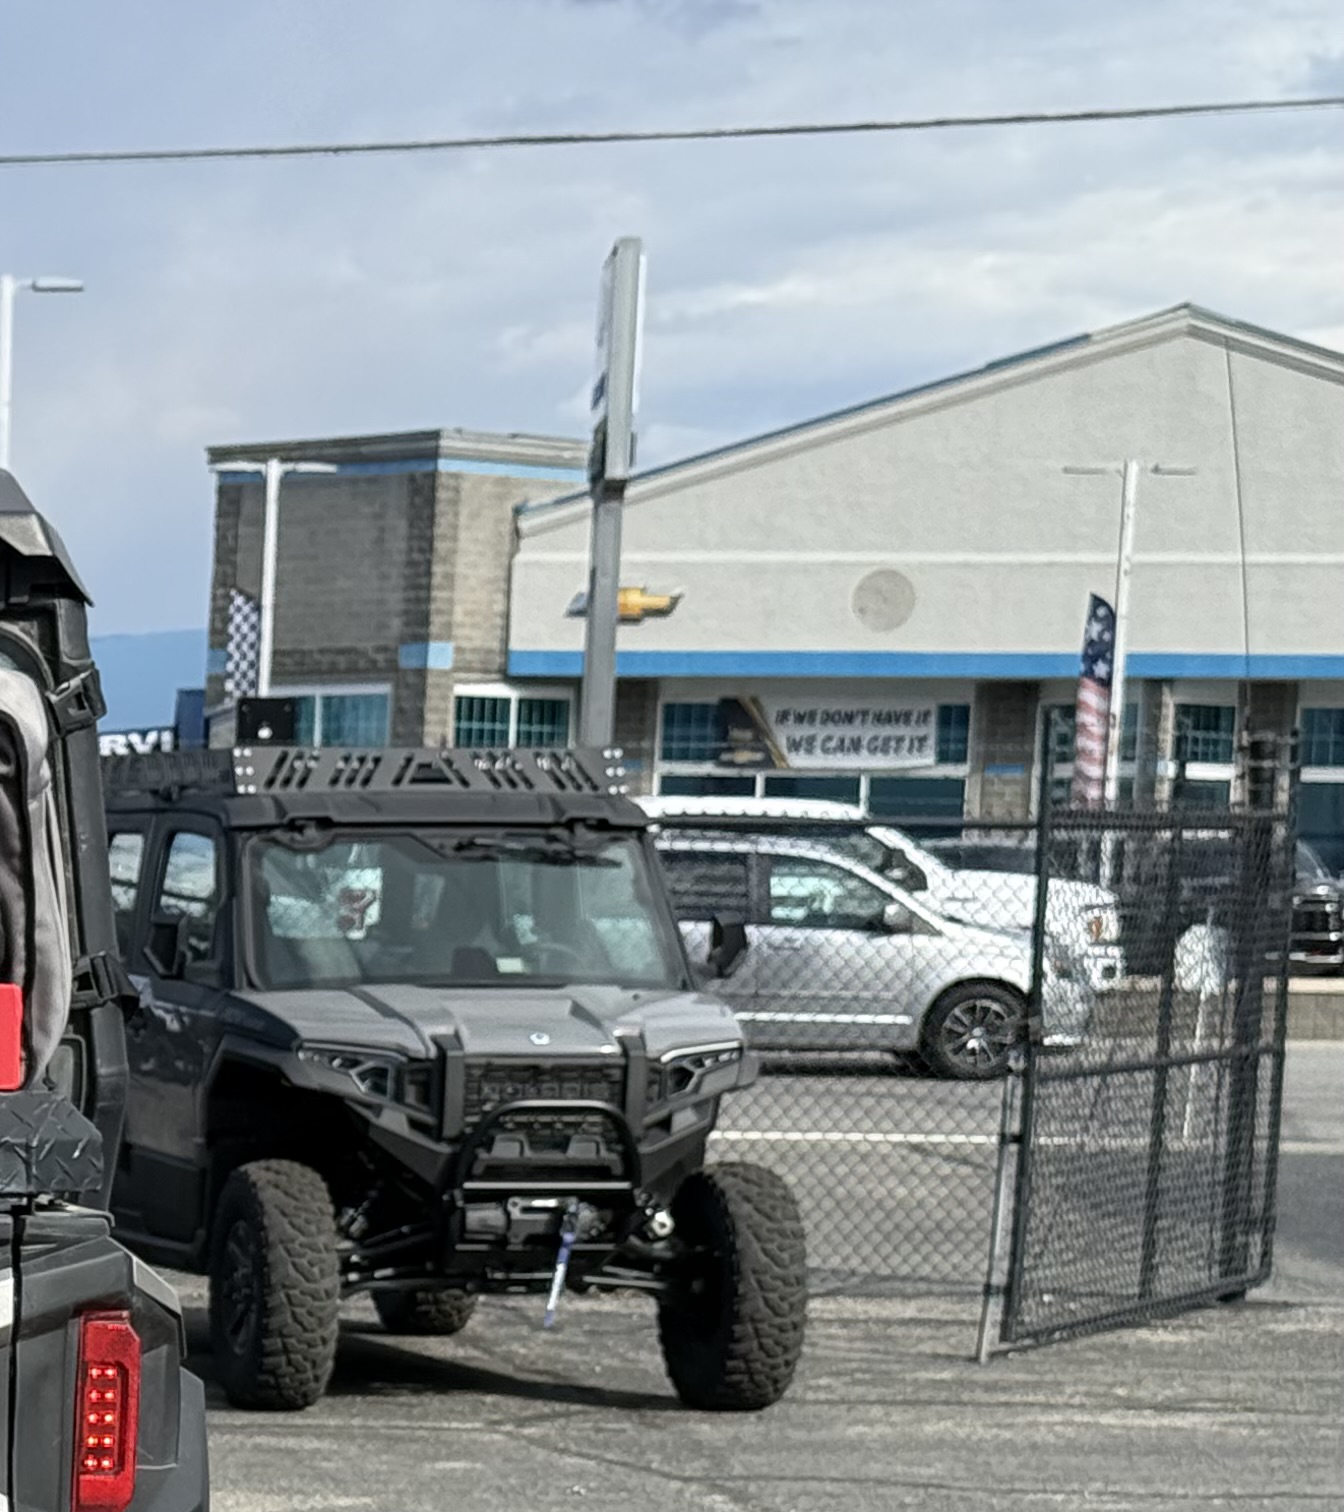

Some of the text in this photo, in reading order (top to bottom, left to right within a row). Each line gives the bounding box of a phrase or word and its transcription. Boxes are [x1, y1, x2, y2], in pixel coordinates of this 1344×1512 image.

[793, 708, 818, 726] WE
[871, 708, 912, 726] HAVE
[786, 734, 928, 755] WE CAN GET IT
